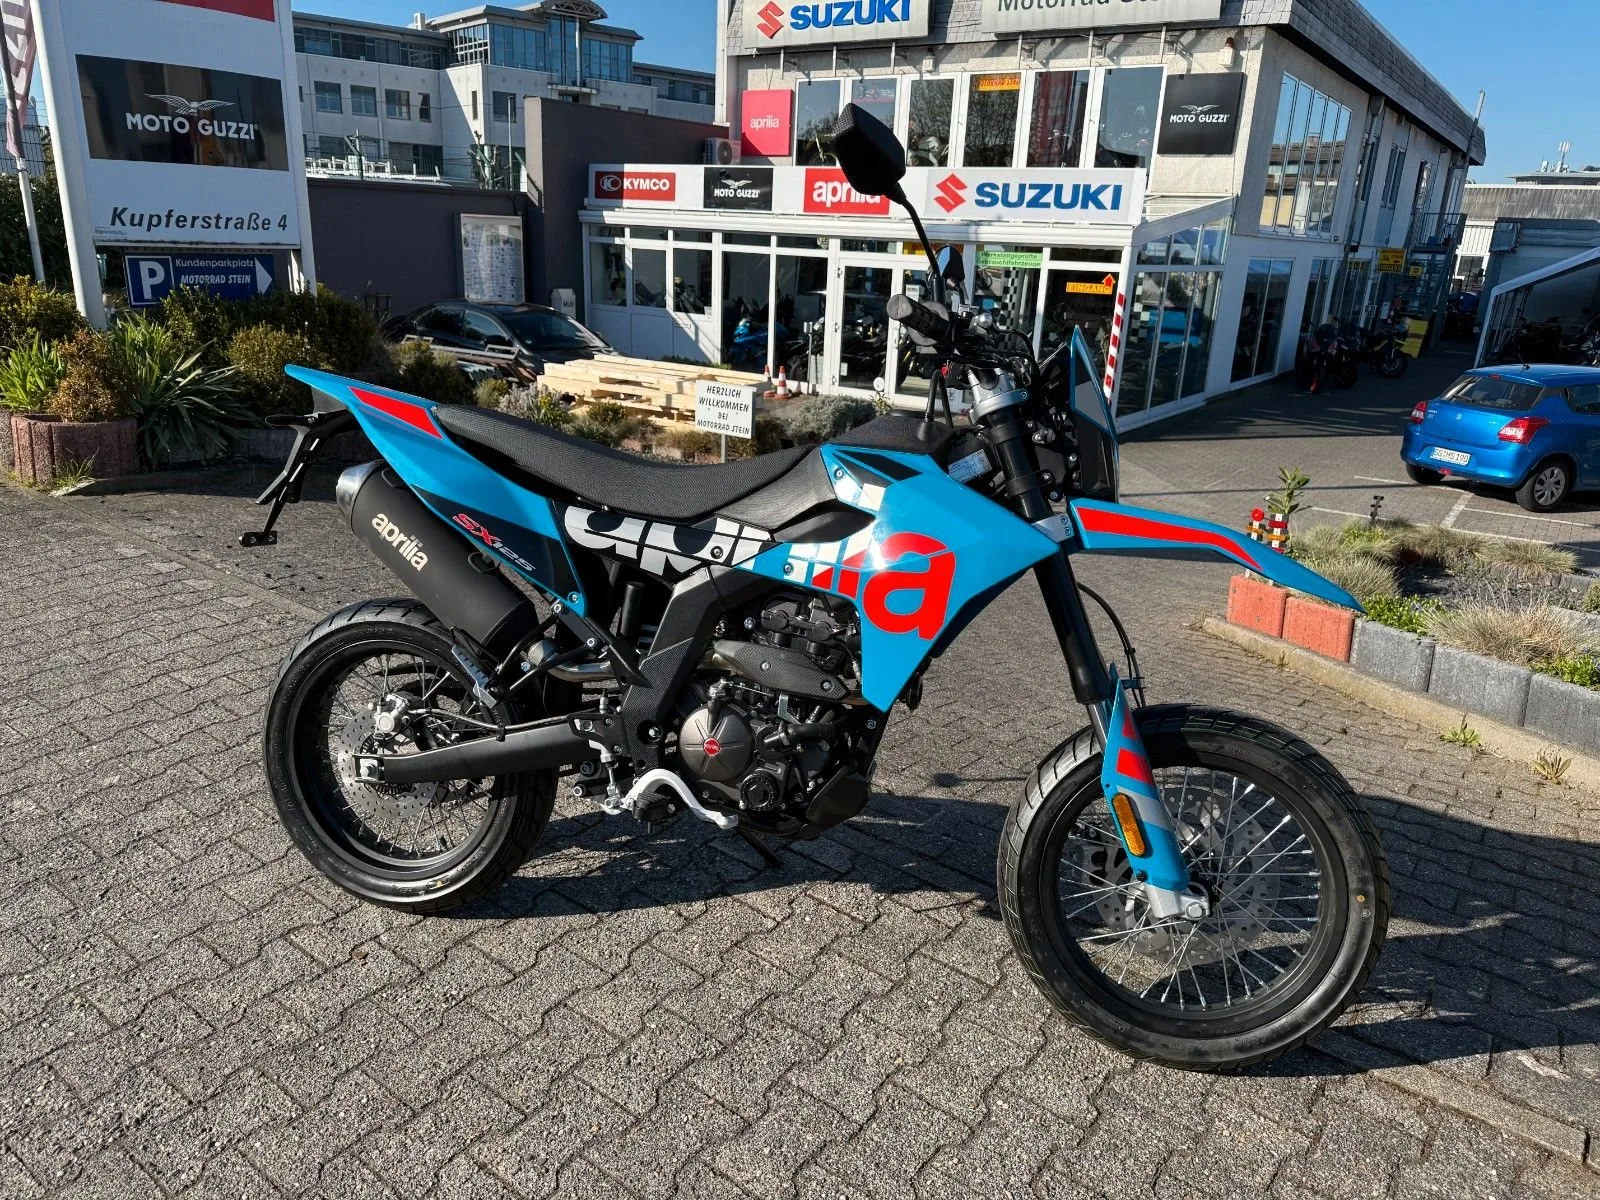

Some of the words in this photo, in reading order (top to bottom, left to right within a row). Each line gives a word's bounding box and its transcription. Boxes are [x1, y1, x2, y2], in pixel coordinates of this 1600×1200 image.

[998, 0, 1109, 11] Moto
[790, 0, 911, 30] SUZUKI
[750, 115, 779, 131] aprilia
[1170, 114, 1195, 123] MOTO
[1199, 114, 1227, 123] GUZZI
[125, 112, 190, 134] MOTO
[197, 119, 255, 140] GUZZI
[623, 178, 670, 191] KYMCO
[714, 188, 734, 198] MOTO
[736, 189, 759, 199] GUZZI
[974, 182, 1123, 210] SUZUKI
[110, 206, 271, 232] Kupferstraße
[277, 214, 288, 231] 4
[176, 258, 253, 268] Kundenparkplatz
[139, 261, 165, 300] P
[181, 274, 226, 284] MOTORRAD
[228, 274, 250, 284] STEIN
[1069, 284, 1111, 293] EINGANG
[707, 385, 741, 398] HERZLICH
[699, 397, 750, 412] WILLKOMMEN
[718, 412, 729, 421] BEI
[696, 420, 730, 431] MOTORRAD
[731, 425, 750, 435] STEIN
[371, 513, 429, 573] aprilia
